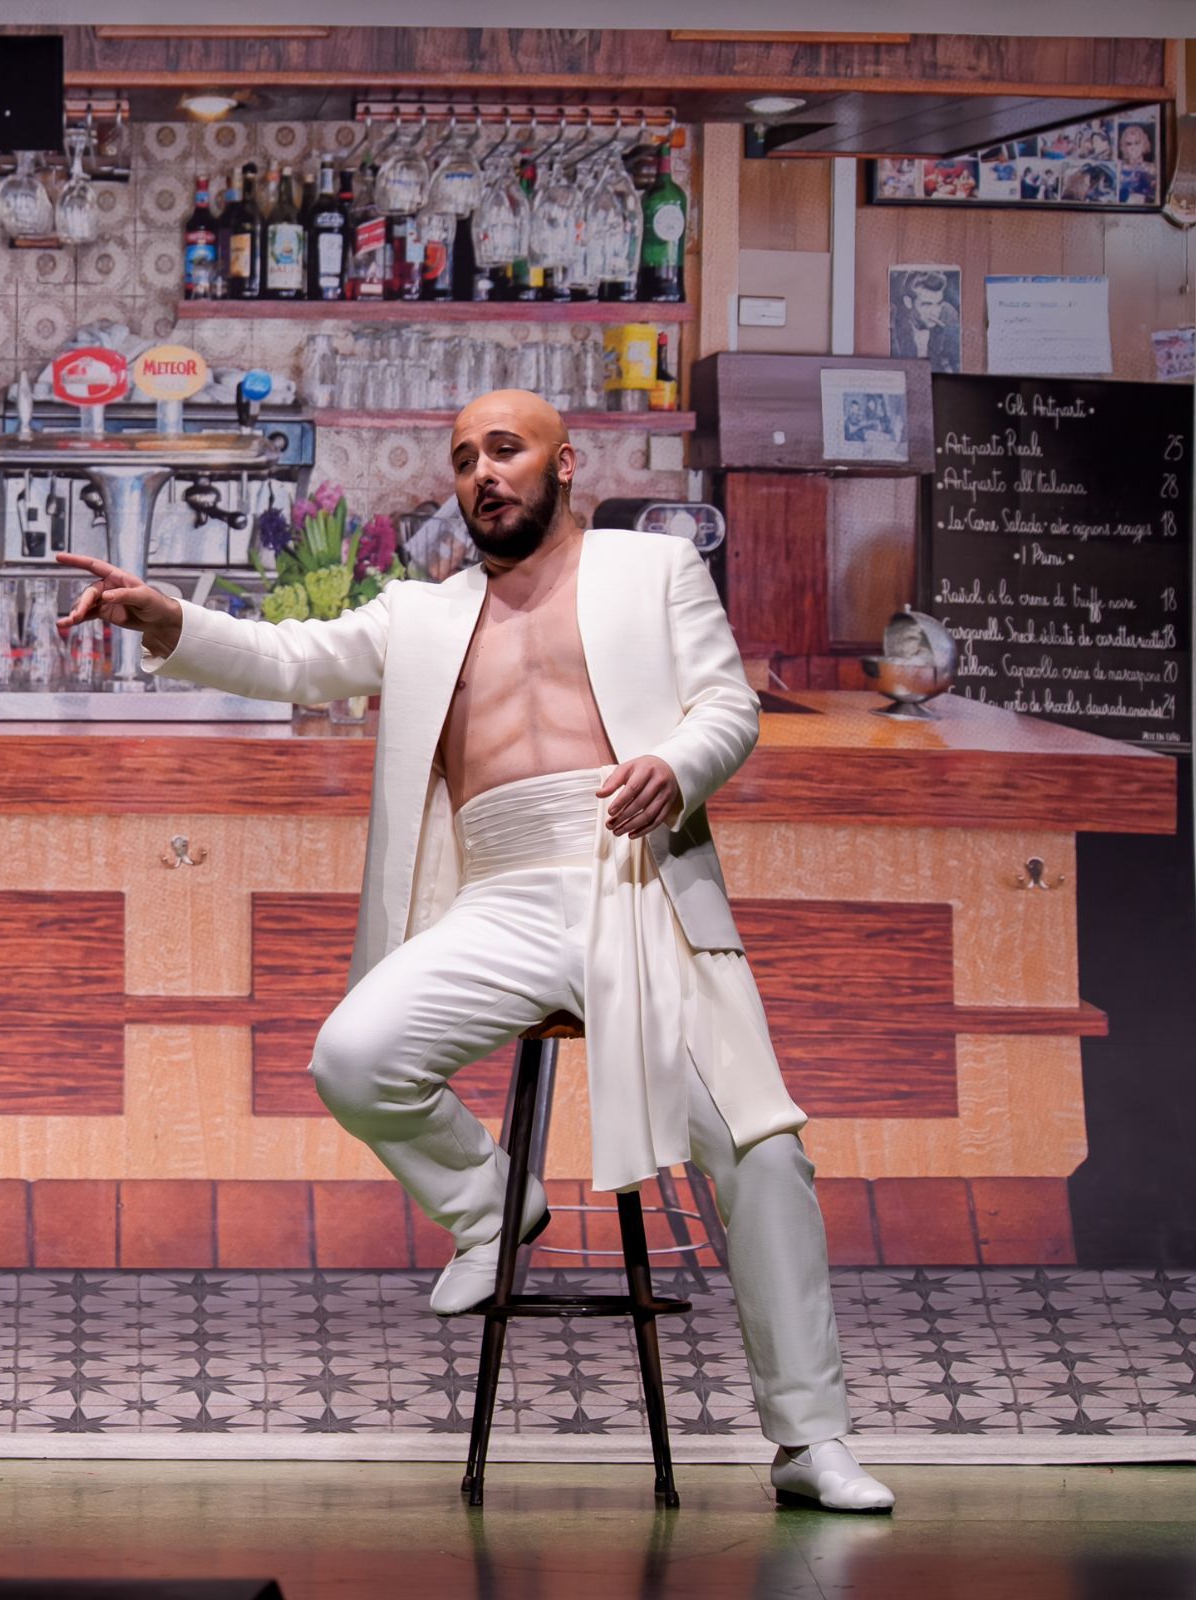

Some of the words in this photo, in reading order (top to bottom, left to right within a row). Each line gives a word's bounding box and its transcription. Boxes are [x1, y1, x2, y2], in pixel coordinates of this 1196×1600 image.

[142, 359, 197, 377] METEOR
[1163, 433, 1185, 462] 25
[1160, 472, 1180, 499] 28
[1160, 510, 1178, 537] 18
[1053, 582, 1067, 607] de
[1160, 586, 1178, 612] 18
[1162, 660, 1179, 684] 20
